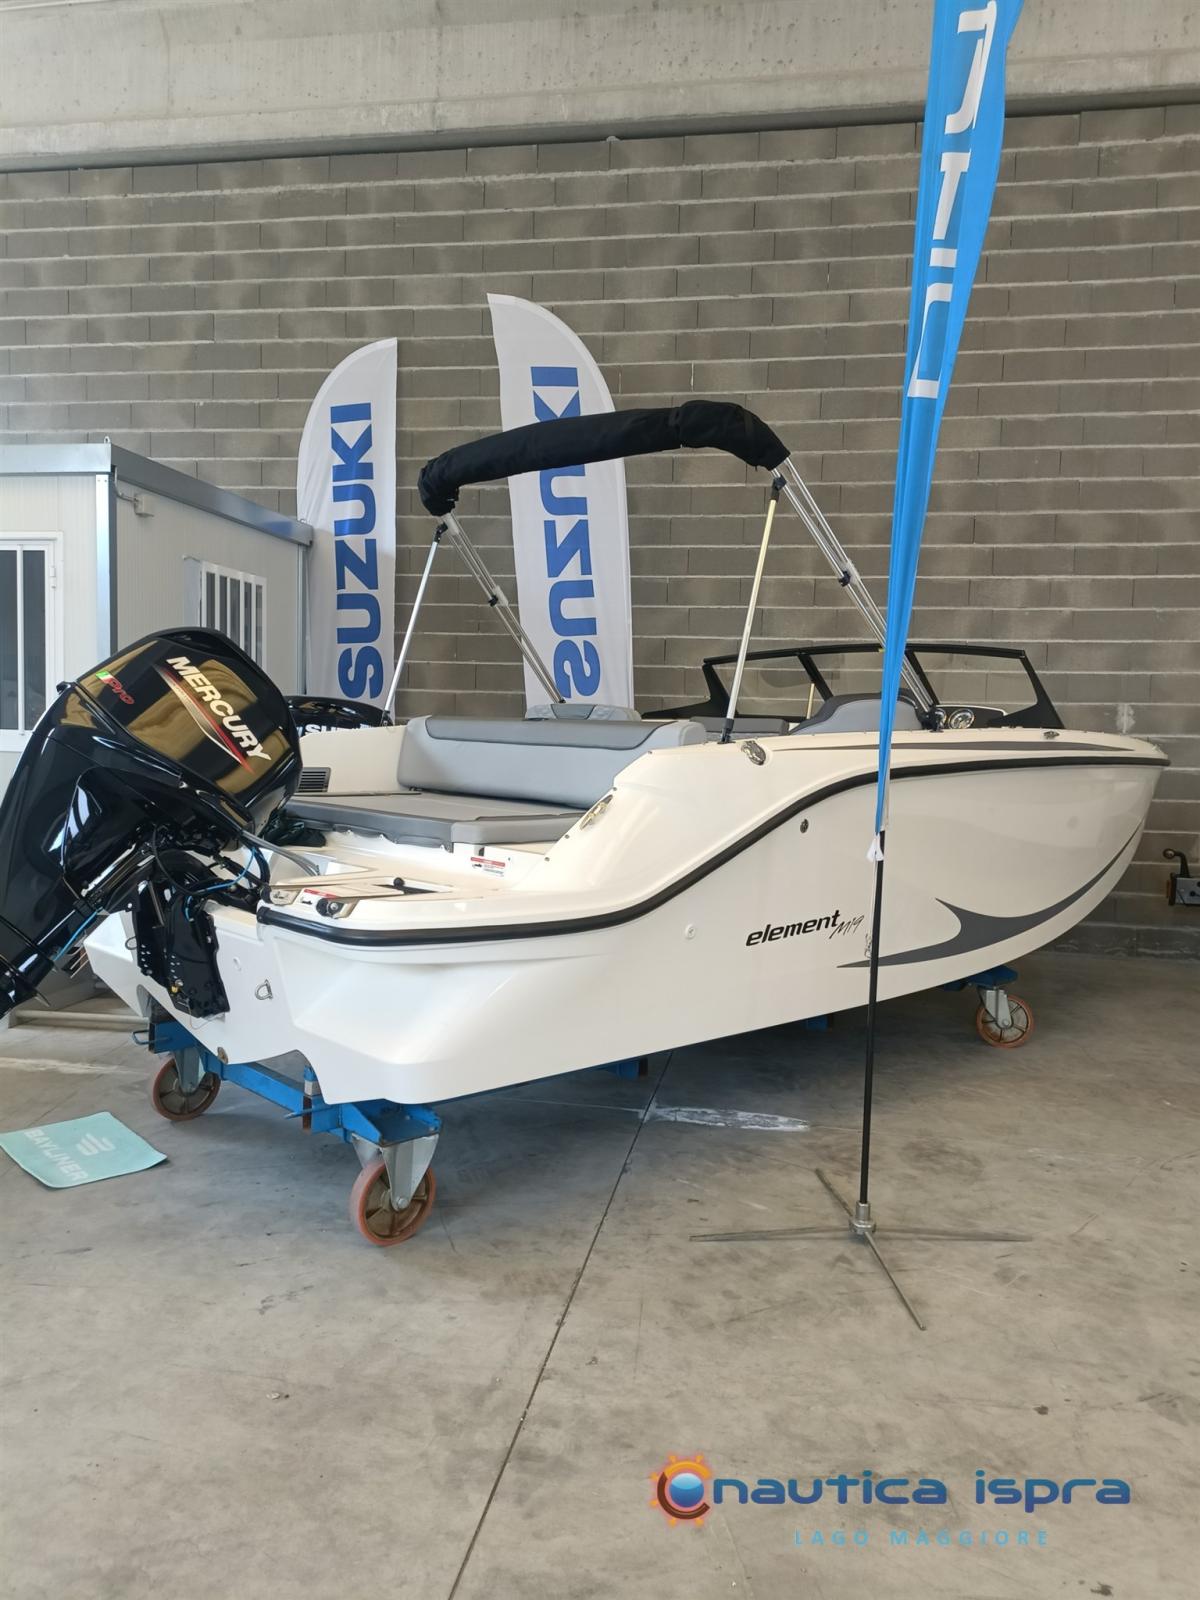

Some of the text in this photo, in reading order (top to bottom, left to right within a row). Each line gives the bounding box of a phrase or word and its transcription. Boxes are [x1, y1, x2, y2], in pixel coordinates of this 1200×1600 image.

[330, 402, 384, 699] SUZUKI
[166, 656, 272, 761] MERCURY
[746, 909, 840, 946] element
[23, 1128, 89, 1182] BAYLINER
